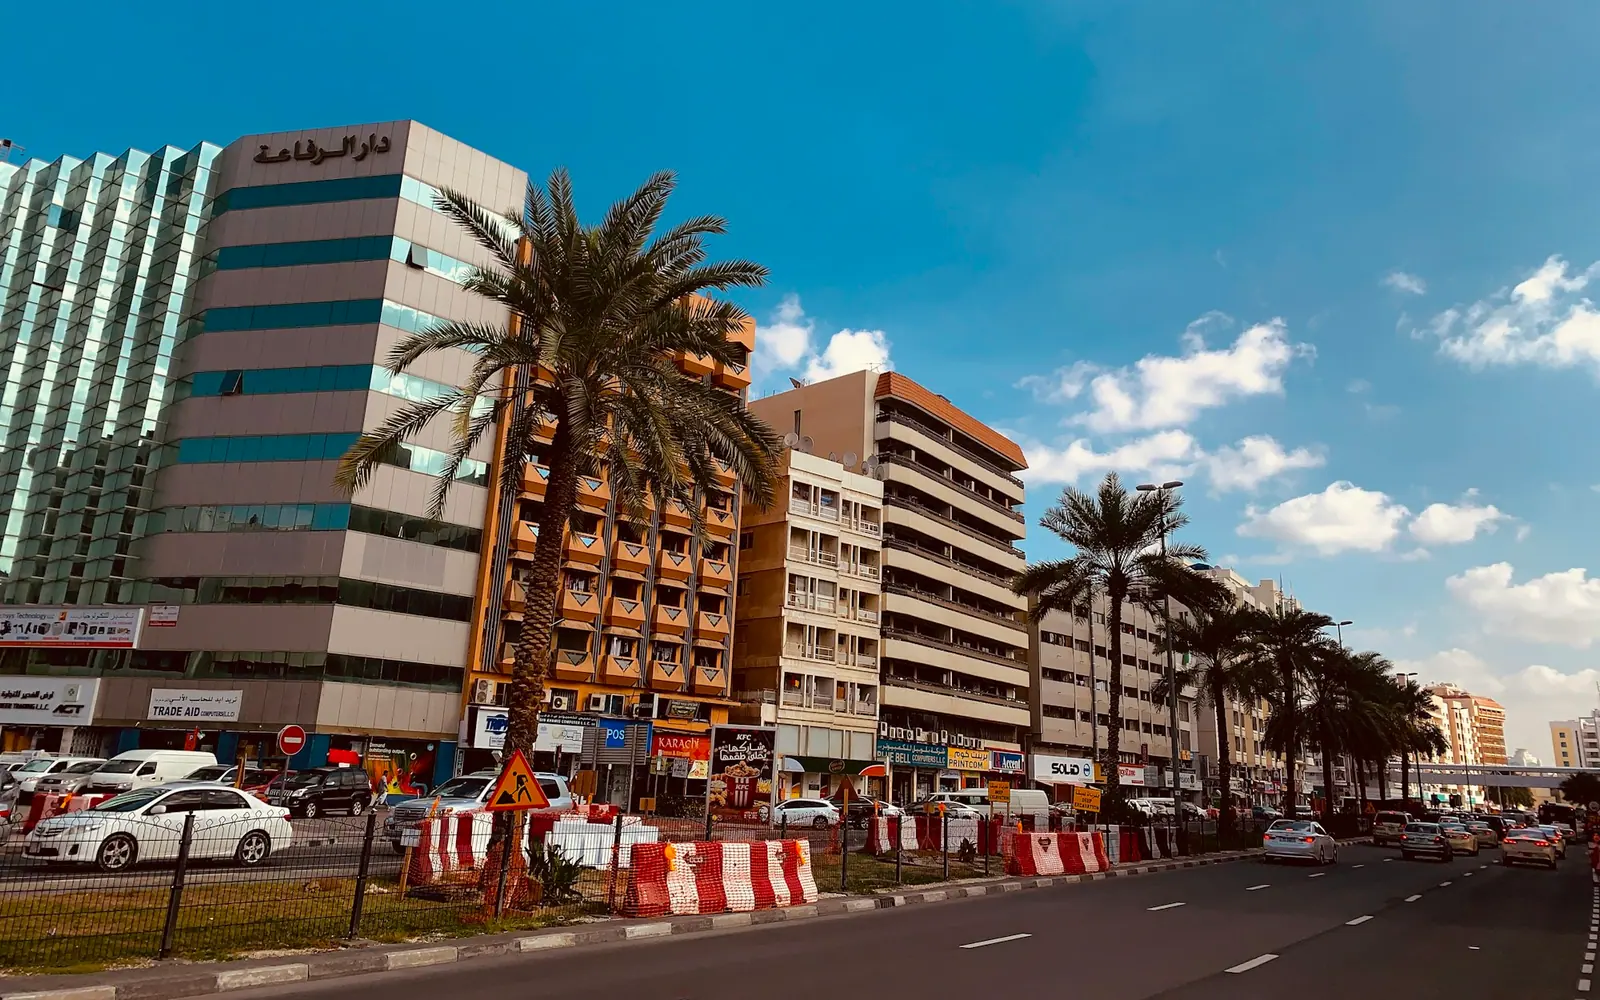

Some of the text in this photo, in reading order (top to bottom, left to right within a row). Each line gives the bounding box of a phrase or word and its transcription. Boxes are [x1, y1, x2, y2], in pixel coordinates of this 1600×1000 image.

[352, 133, 391, 162] دار
[153, 706, 183, 717] TRADE
[184, 707, 200, 717] AID
[606, 728, 625, 740] POS
[895, 753, 912, 764] BELL
[949, 758, 983, 769] PRINTCOM
[1002, 756, 1021, 769] Accent
